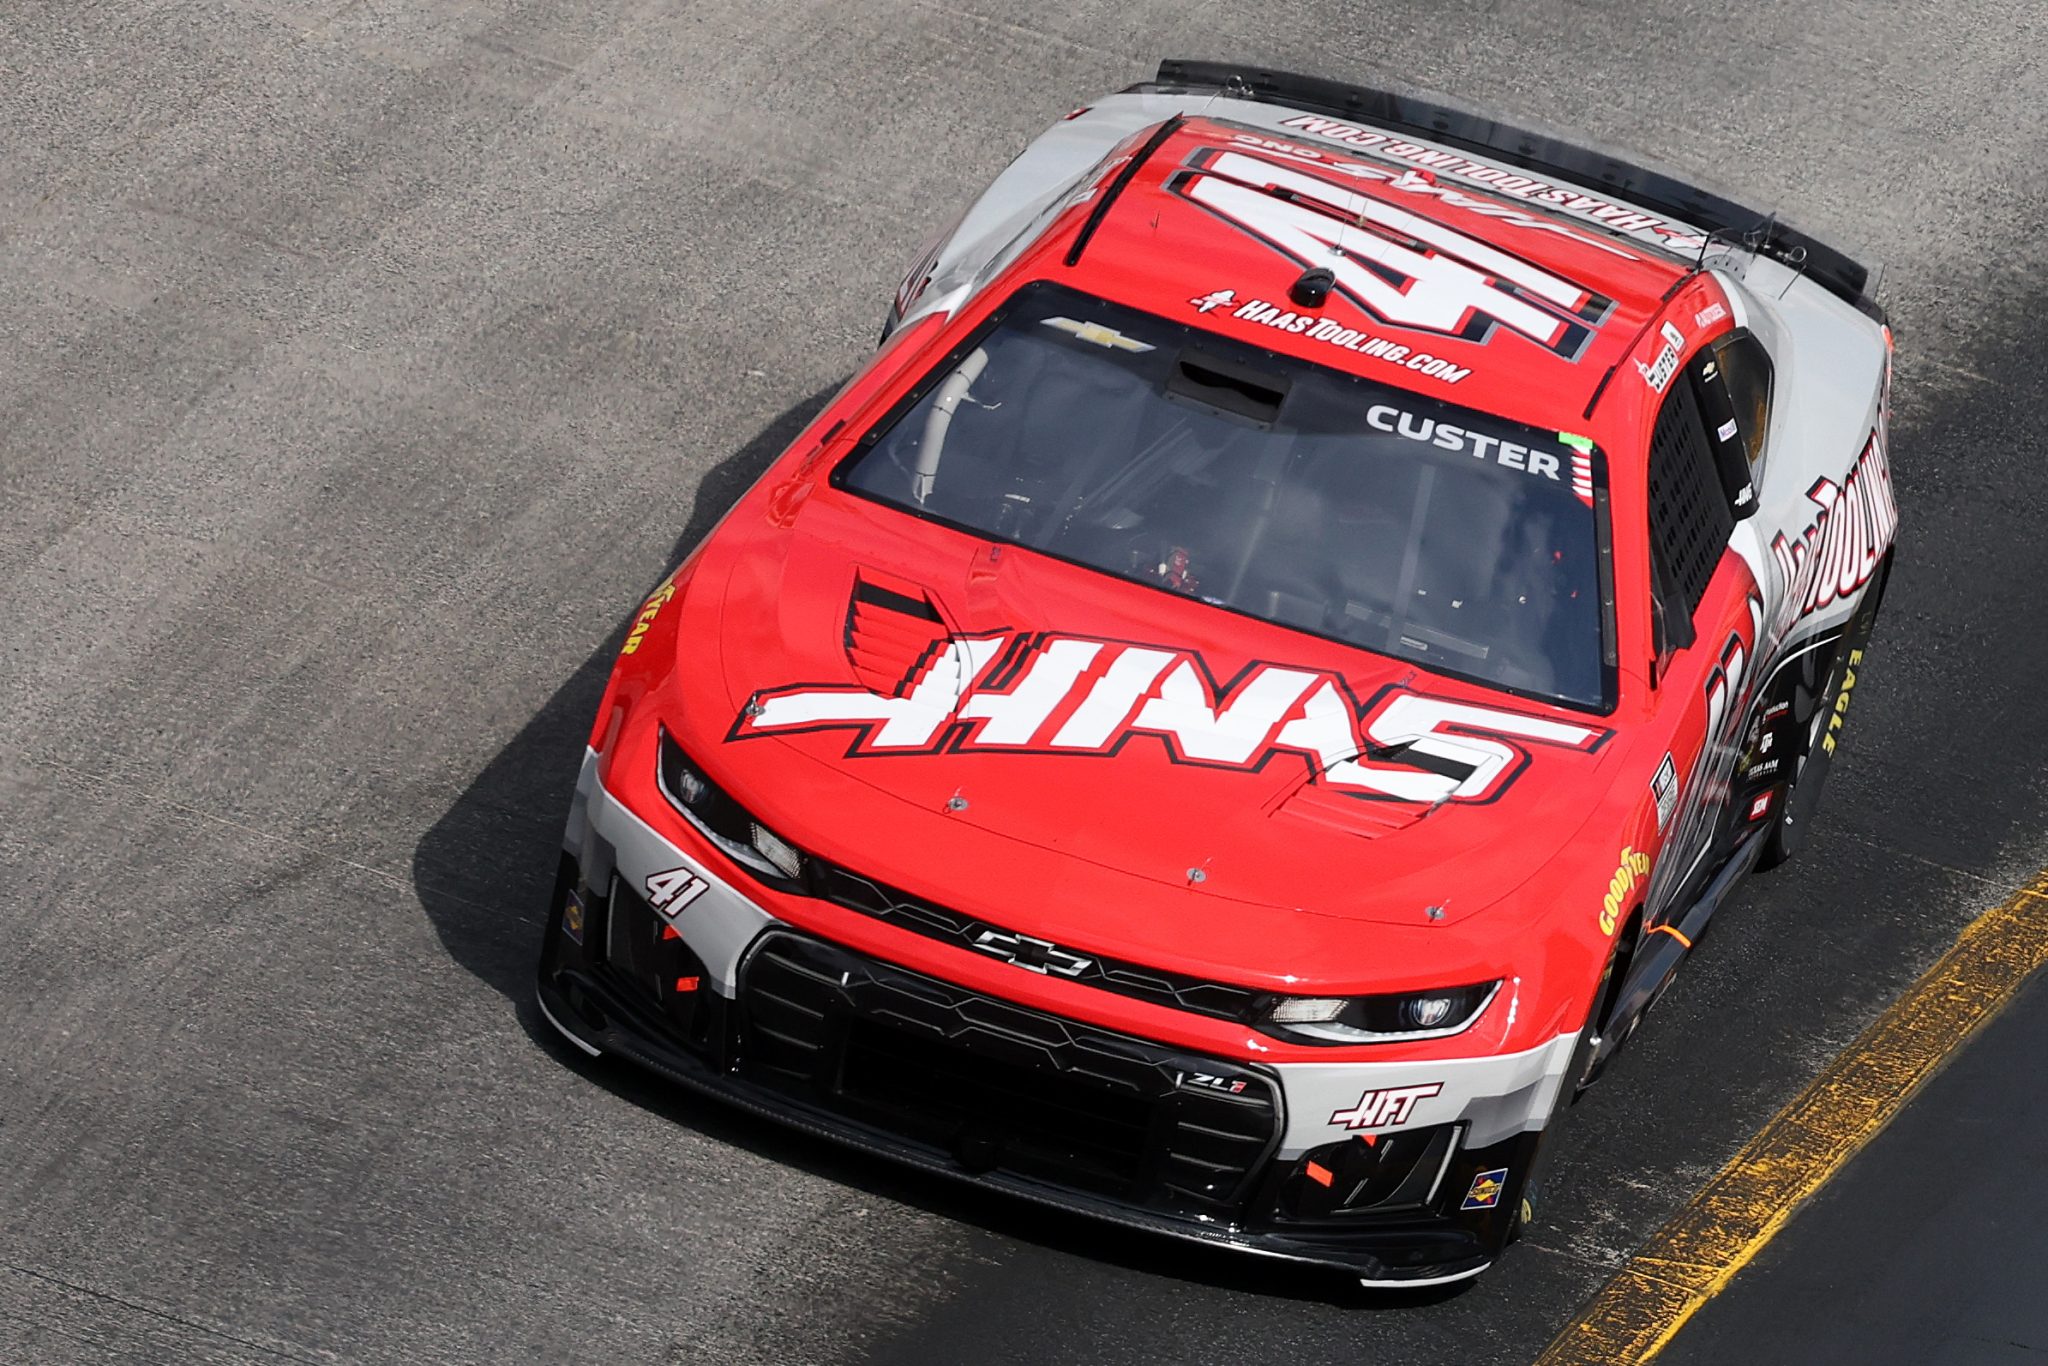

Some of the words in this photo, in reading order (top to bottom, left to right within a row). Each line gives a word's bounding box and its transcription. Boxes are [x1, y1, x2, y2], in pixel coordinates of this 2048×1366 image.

[1164, 146, 1618, 363] 41
[1233, 298, 1472, 385] HAASTOOLING.COM
[1366, 403, 1562, 481] CUSTER
[726, 627, 1618, 807] HAAS
[1822, 649, 1863, 759] EAGLE
[645, 866, 710, 919] 41
[1187, 1072, 1247, 1094] ZL1
